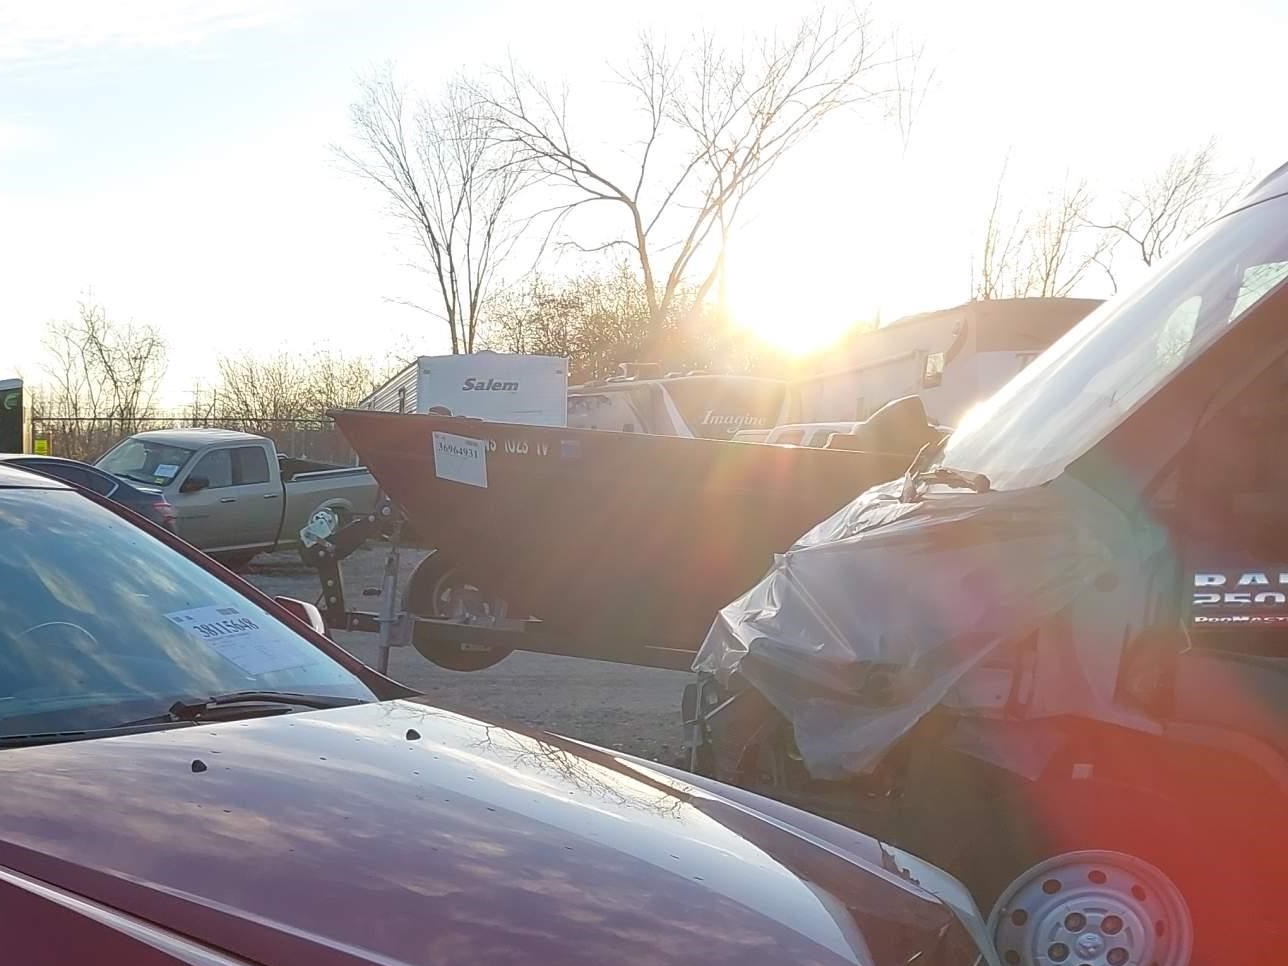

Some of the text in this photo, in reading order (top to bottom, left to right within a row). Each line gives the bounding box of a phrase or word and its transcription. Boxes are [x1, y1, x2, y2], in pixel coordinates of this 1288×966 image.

[462, 378, 519, 391] Salem
[701, 408, 766, 434] Imagine
[193, 617, 260, 638] 38115648
